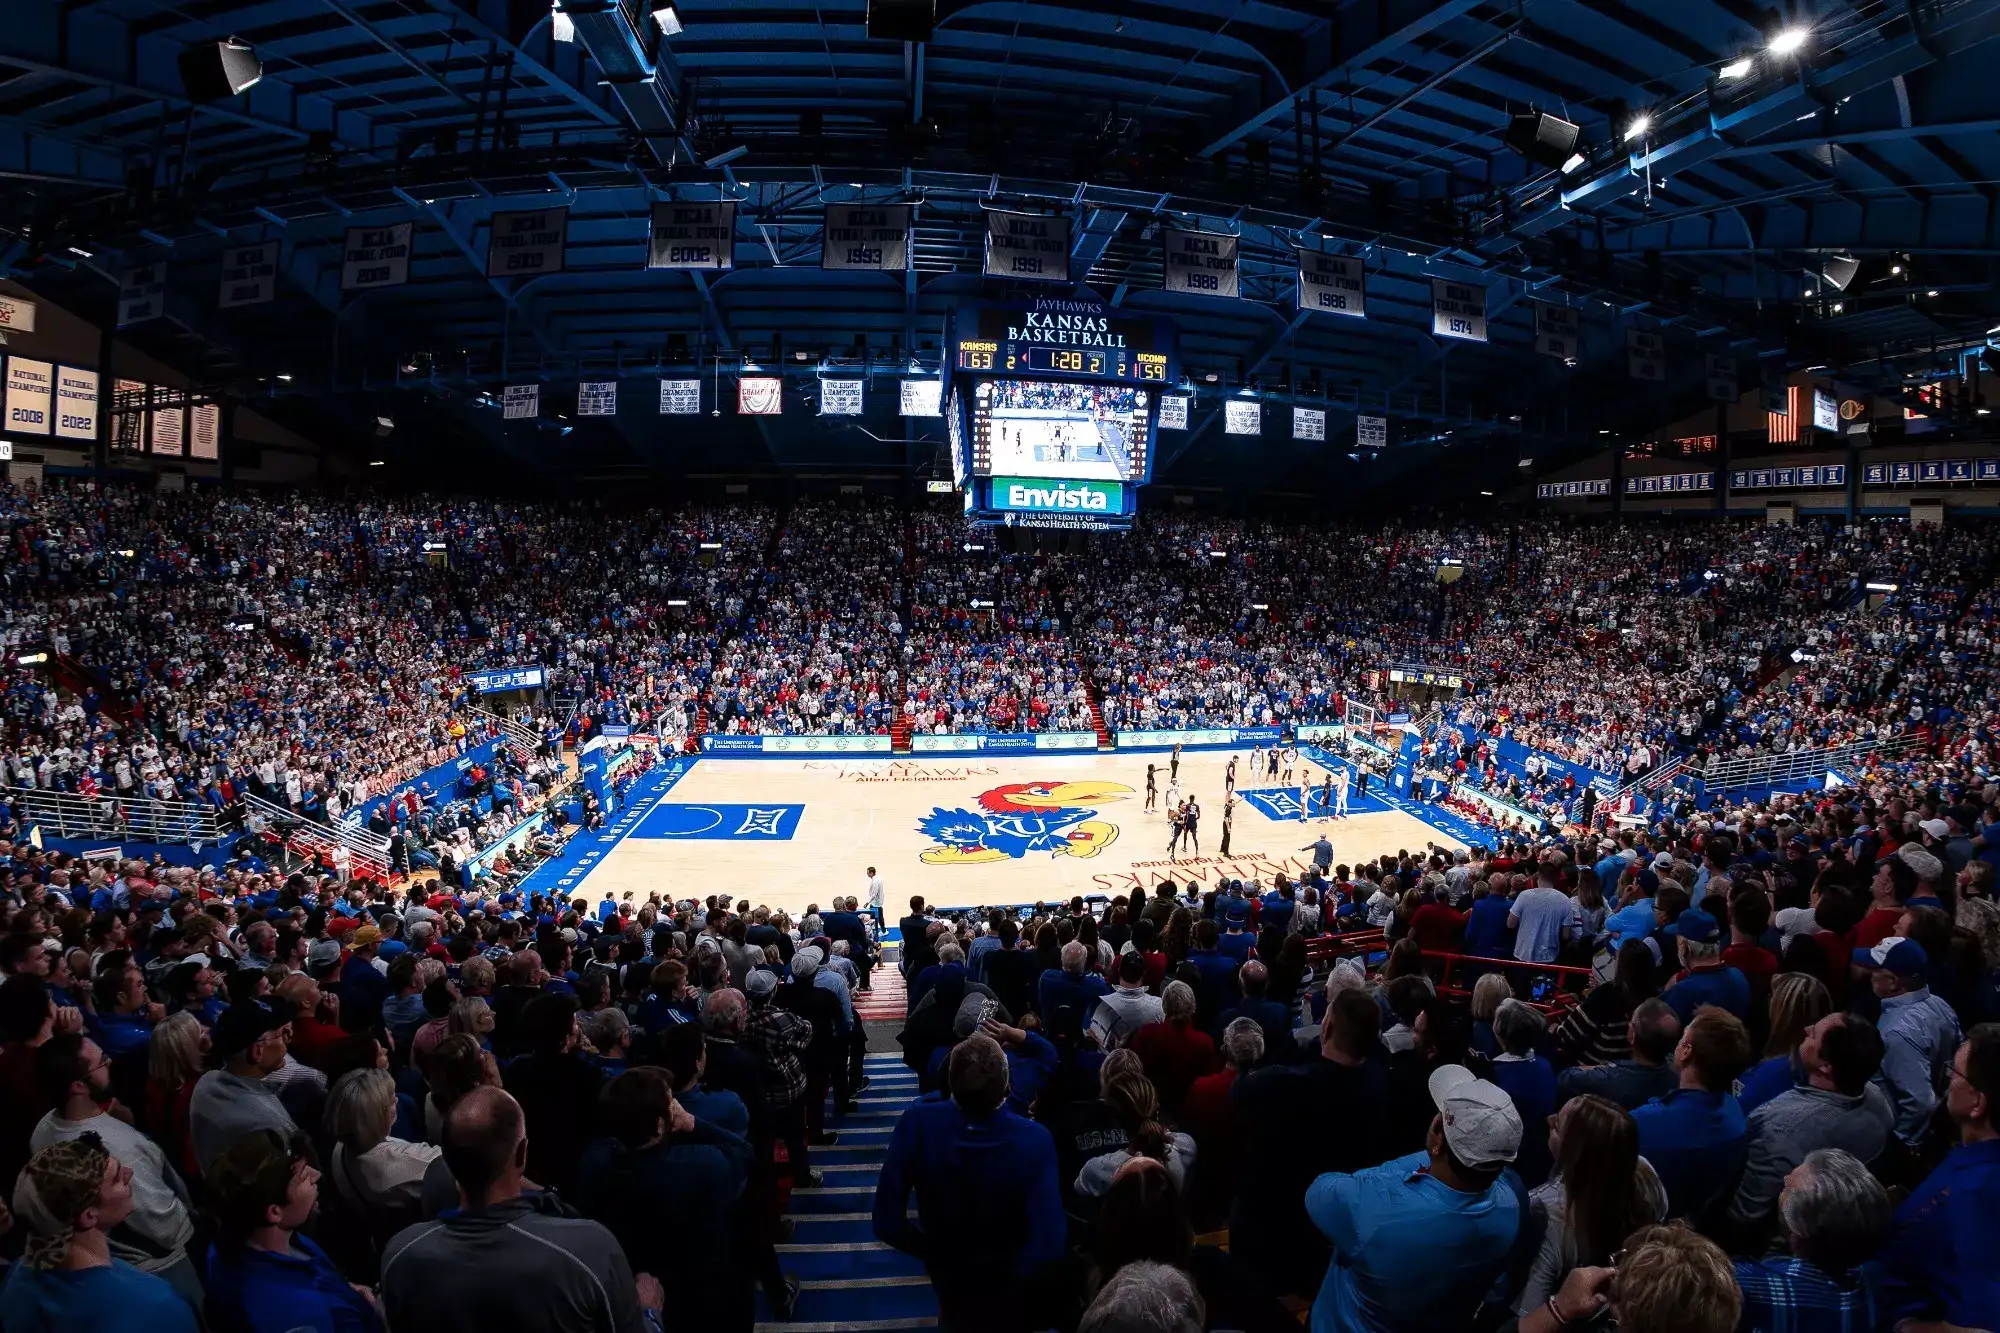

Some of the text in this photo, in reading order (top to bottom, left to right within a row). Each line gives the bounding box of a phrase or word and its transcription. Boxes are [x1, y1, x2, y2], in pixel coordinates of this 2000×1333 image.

[671, 248, 710, 262] 2002
[847, 249, 882, 263] 1993
[1012, 256, 1042, 272] 1991
[1186, 276, 1218, 290] 1988
[1035, 299, 1102, 314] JAYHAWKS
[1318, 293, 1346, 309] 1986
[1026, 312, 1107, 332] KANSAS
[1449, 320, 1472, 334] 1974
[1008, 327, 1126, 348] BASKETBALL
[960, 342, 997, 352] KANSAS
[971, 354, 990, 367] 63
[1007, 357, 1015, 369] 2
[1051, 352, 1082, 368] 1:28
[1090, 358, 1099, 372] 2
[1137, 353, 1167, 363] UCONN
[1118, 363, 1125, 376] 2
[1144, 365, 1163, 378] 59
[9, 380, 51, 394] CHAMPIONS
[58, 389, 98, 402] CHAMPIONS
[12, 408, 43, 424] 2008
[61, 415, 91, 430] 2022
[1870, 468, 1881, 478] 45
[1897, 467, 1909, 477] 34
[1929, 467, 1935, 476] 0
[1956, 465, 1962, 475] 4
[1985, 464, 1997, 474] 10
[1735, 475, 1745, 484] 40
[1008, 483, 1106, 509] Envista
[1020, 512, 1036, 520] THE
[1038, 513, 1086, 521] UNIVERSITY
[1020, 520, 1109, 530] KANSAS HEALTH SYSTEM
[837, 766, 999, 779] JAYHAWKS
[598, 797, 655, 842] Naismith
[983, 818, 1048, 839] KU
[1229, 852, 1268, 862] Allen
[1092, 856, 1309, 890] JAYHAWKS
